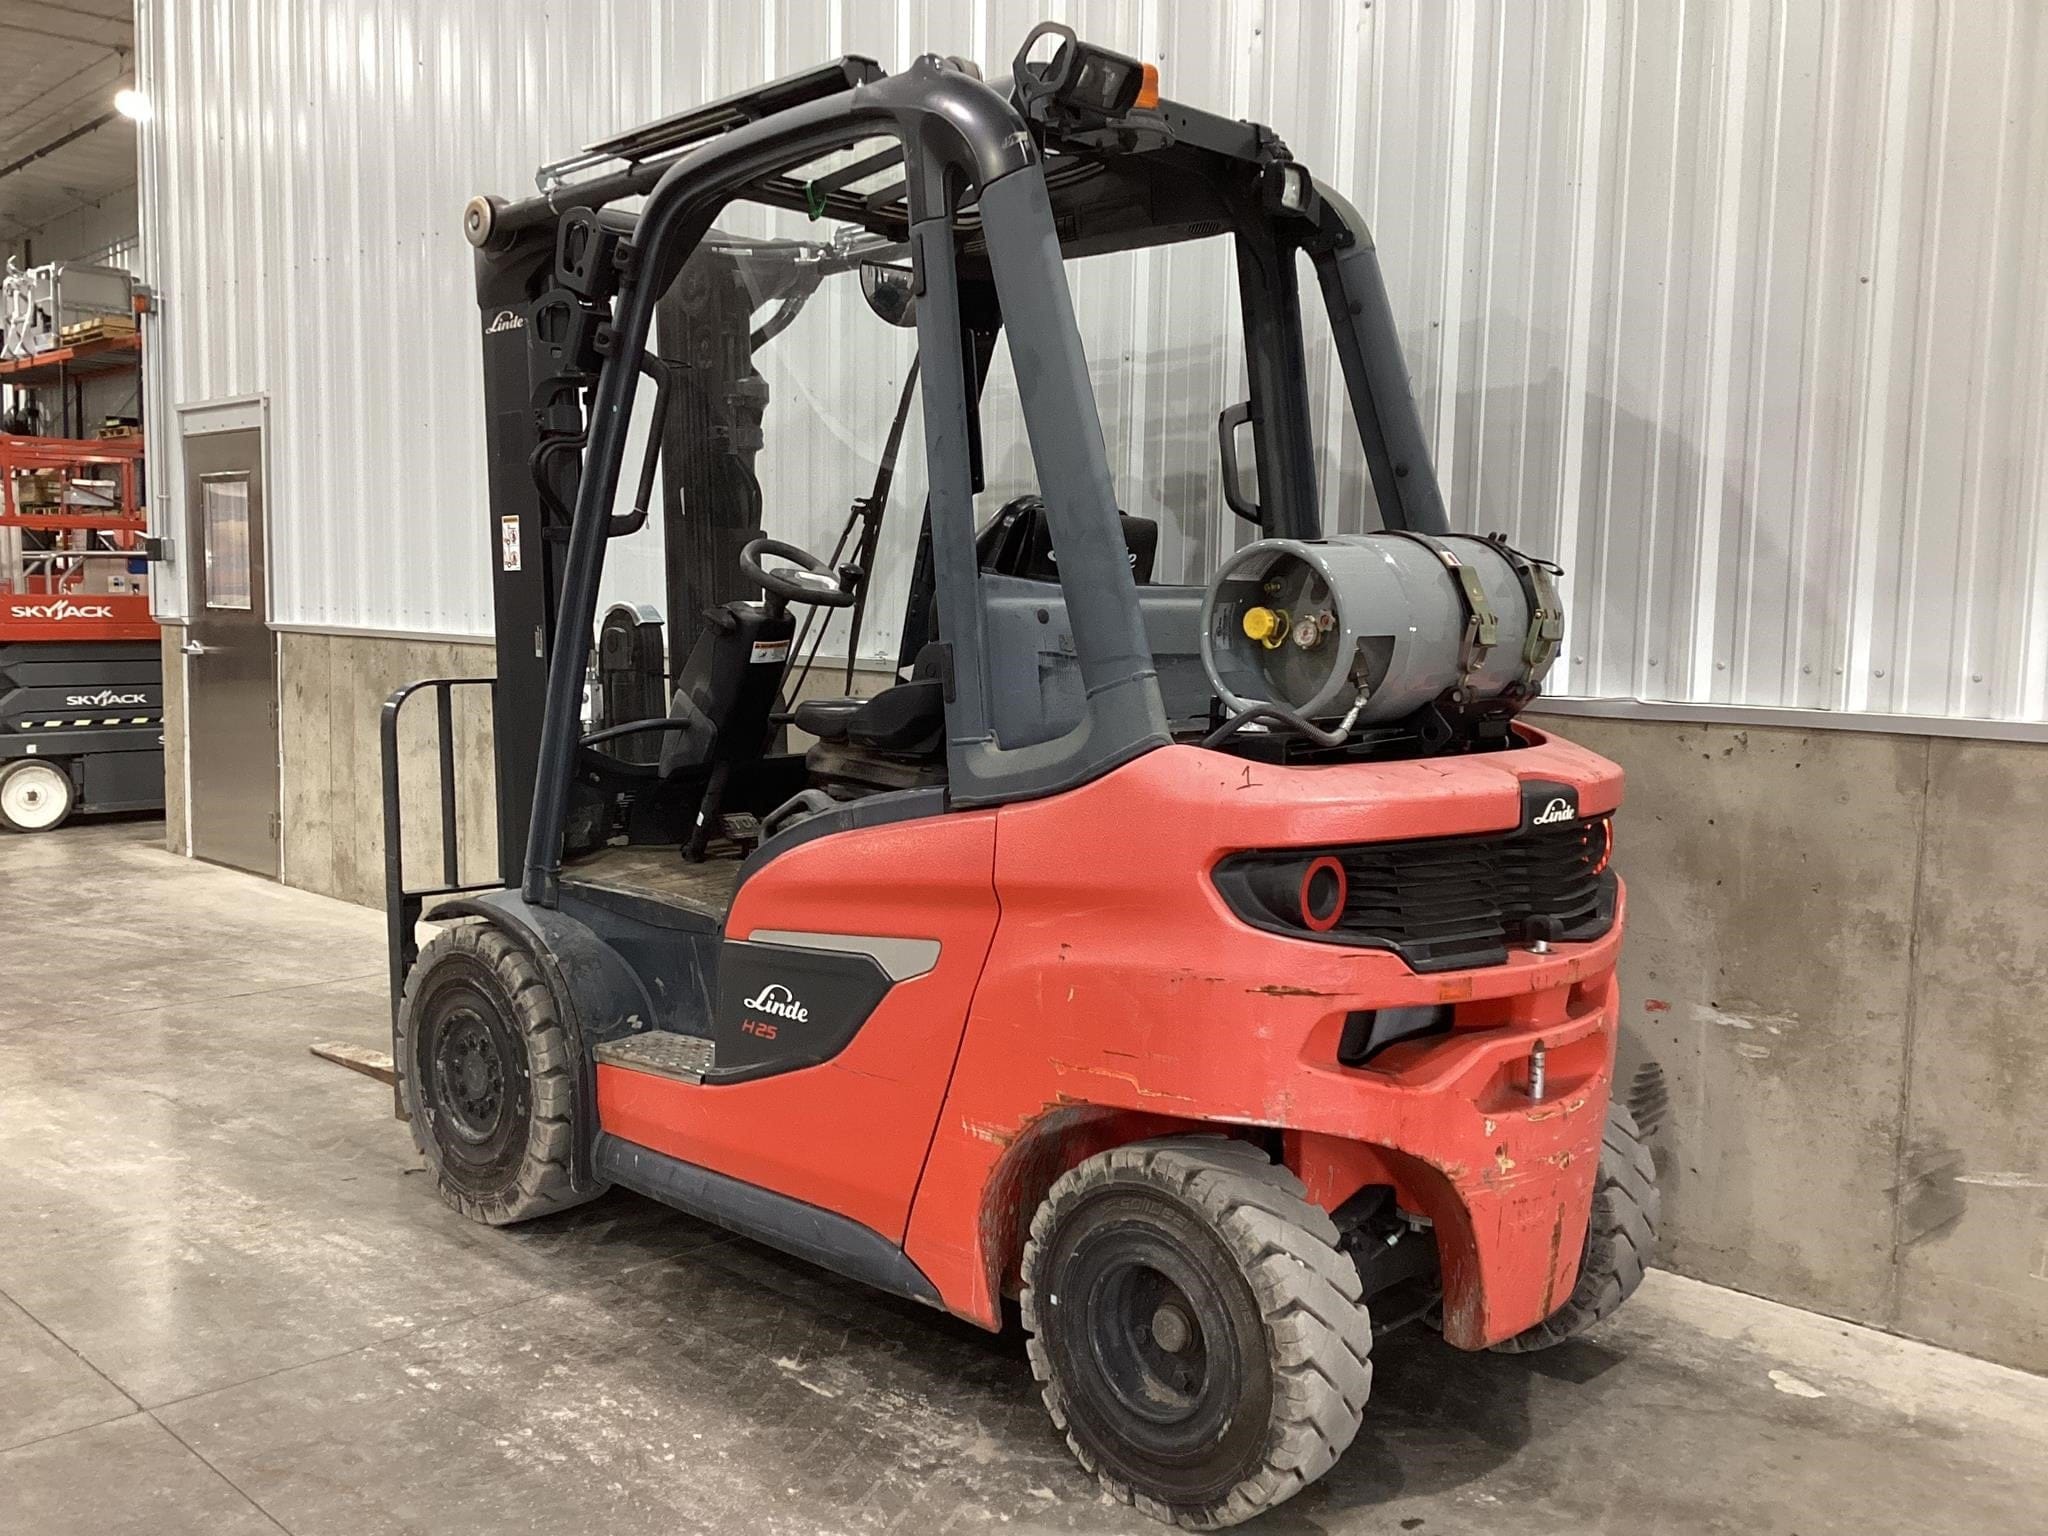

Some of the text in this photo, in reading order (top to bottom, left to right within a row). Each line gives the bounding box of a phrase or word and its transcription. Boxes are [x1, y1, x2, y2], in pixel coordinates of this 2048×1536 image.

[485, 310, 525, 334] Linde
[11, 599, 114, 621] SKYJACK
[66, 690, 148, 707] SKYJACK
[1533, 797, 1575, 825] Linde
[743, 983, 809, 1023] Linde
